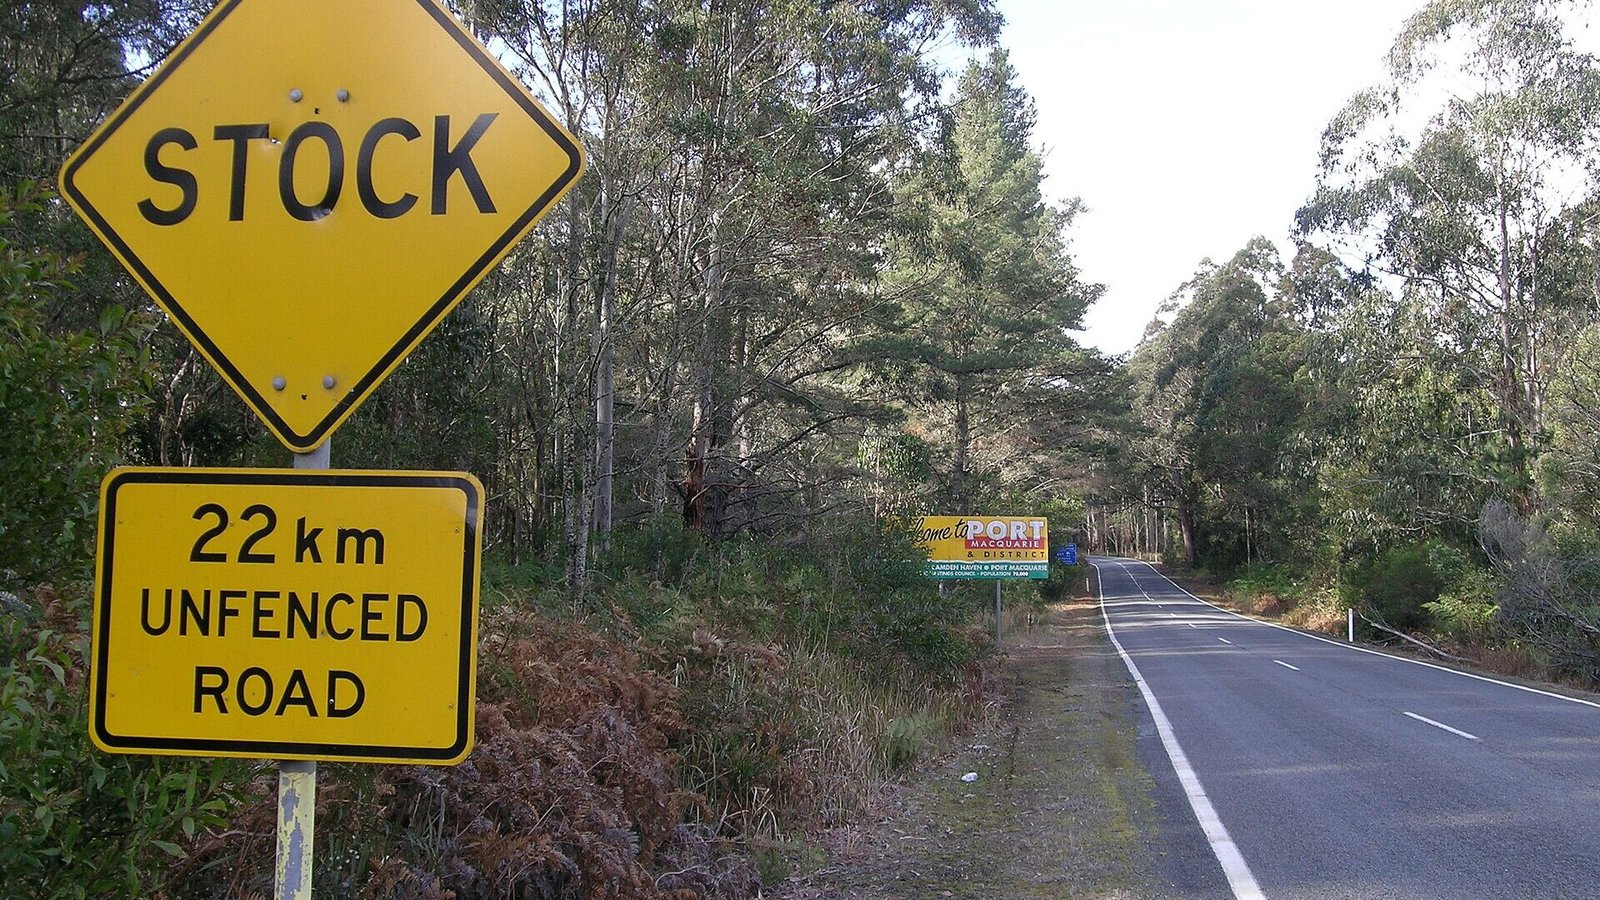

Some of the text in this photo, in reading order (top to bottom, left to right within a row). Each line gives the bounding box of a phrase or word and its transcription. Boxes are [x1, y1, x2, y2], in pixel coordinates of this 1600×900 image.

[137, 113, 499, 226] STOCK
[190, 503, 385, 565] 22 km
[914, 517, 1045, 542] lcome to PORT
[971, 540, 1039, 548] MACQUARIE
[140, 588, 428, 642] UNFENCED
[193, 665, 366, 718] ROAD
